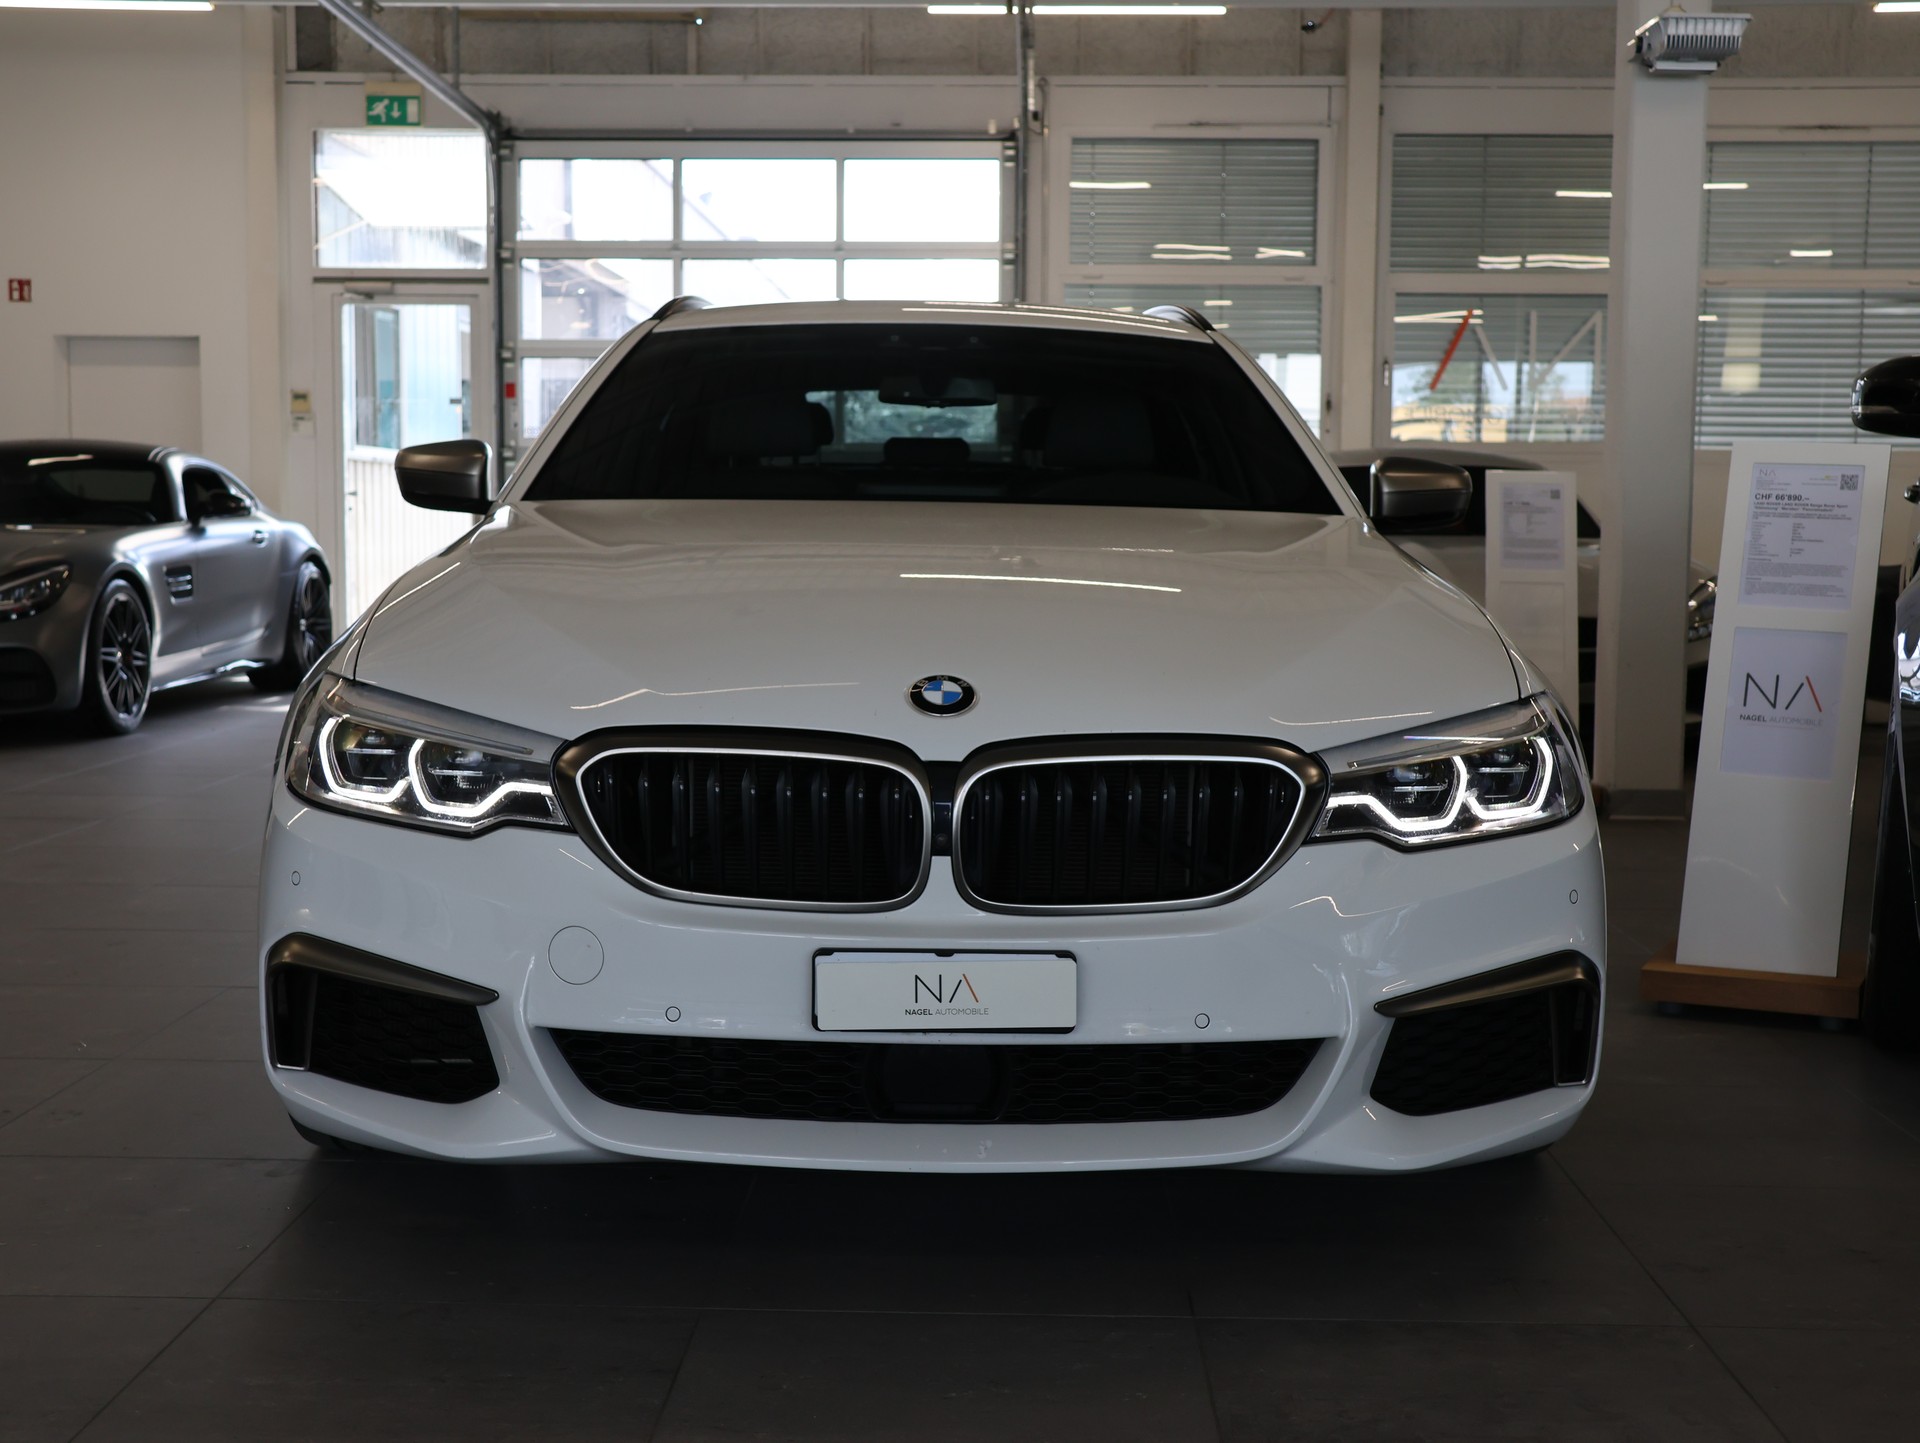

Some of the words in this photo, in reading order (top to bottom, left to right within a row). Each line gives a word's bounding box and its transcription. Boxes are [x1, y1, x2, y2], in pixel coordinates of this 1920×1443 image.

[1754, 493, 1773, 501] CHF
[916, 675, 969, 688] BMW
[1739, 714, 1767, 723] NAGEL
[1769, 716, 1823, 726] AUTOMOBILE
[904, 1008, 933, 1016] NAGEL
[935, 1007, 989, 1016] AUTOMOBILE
